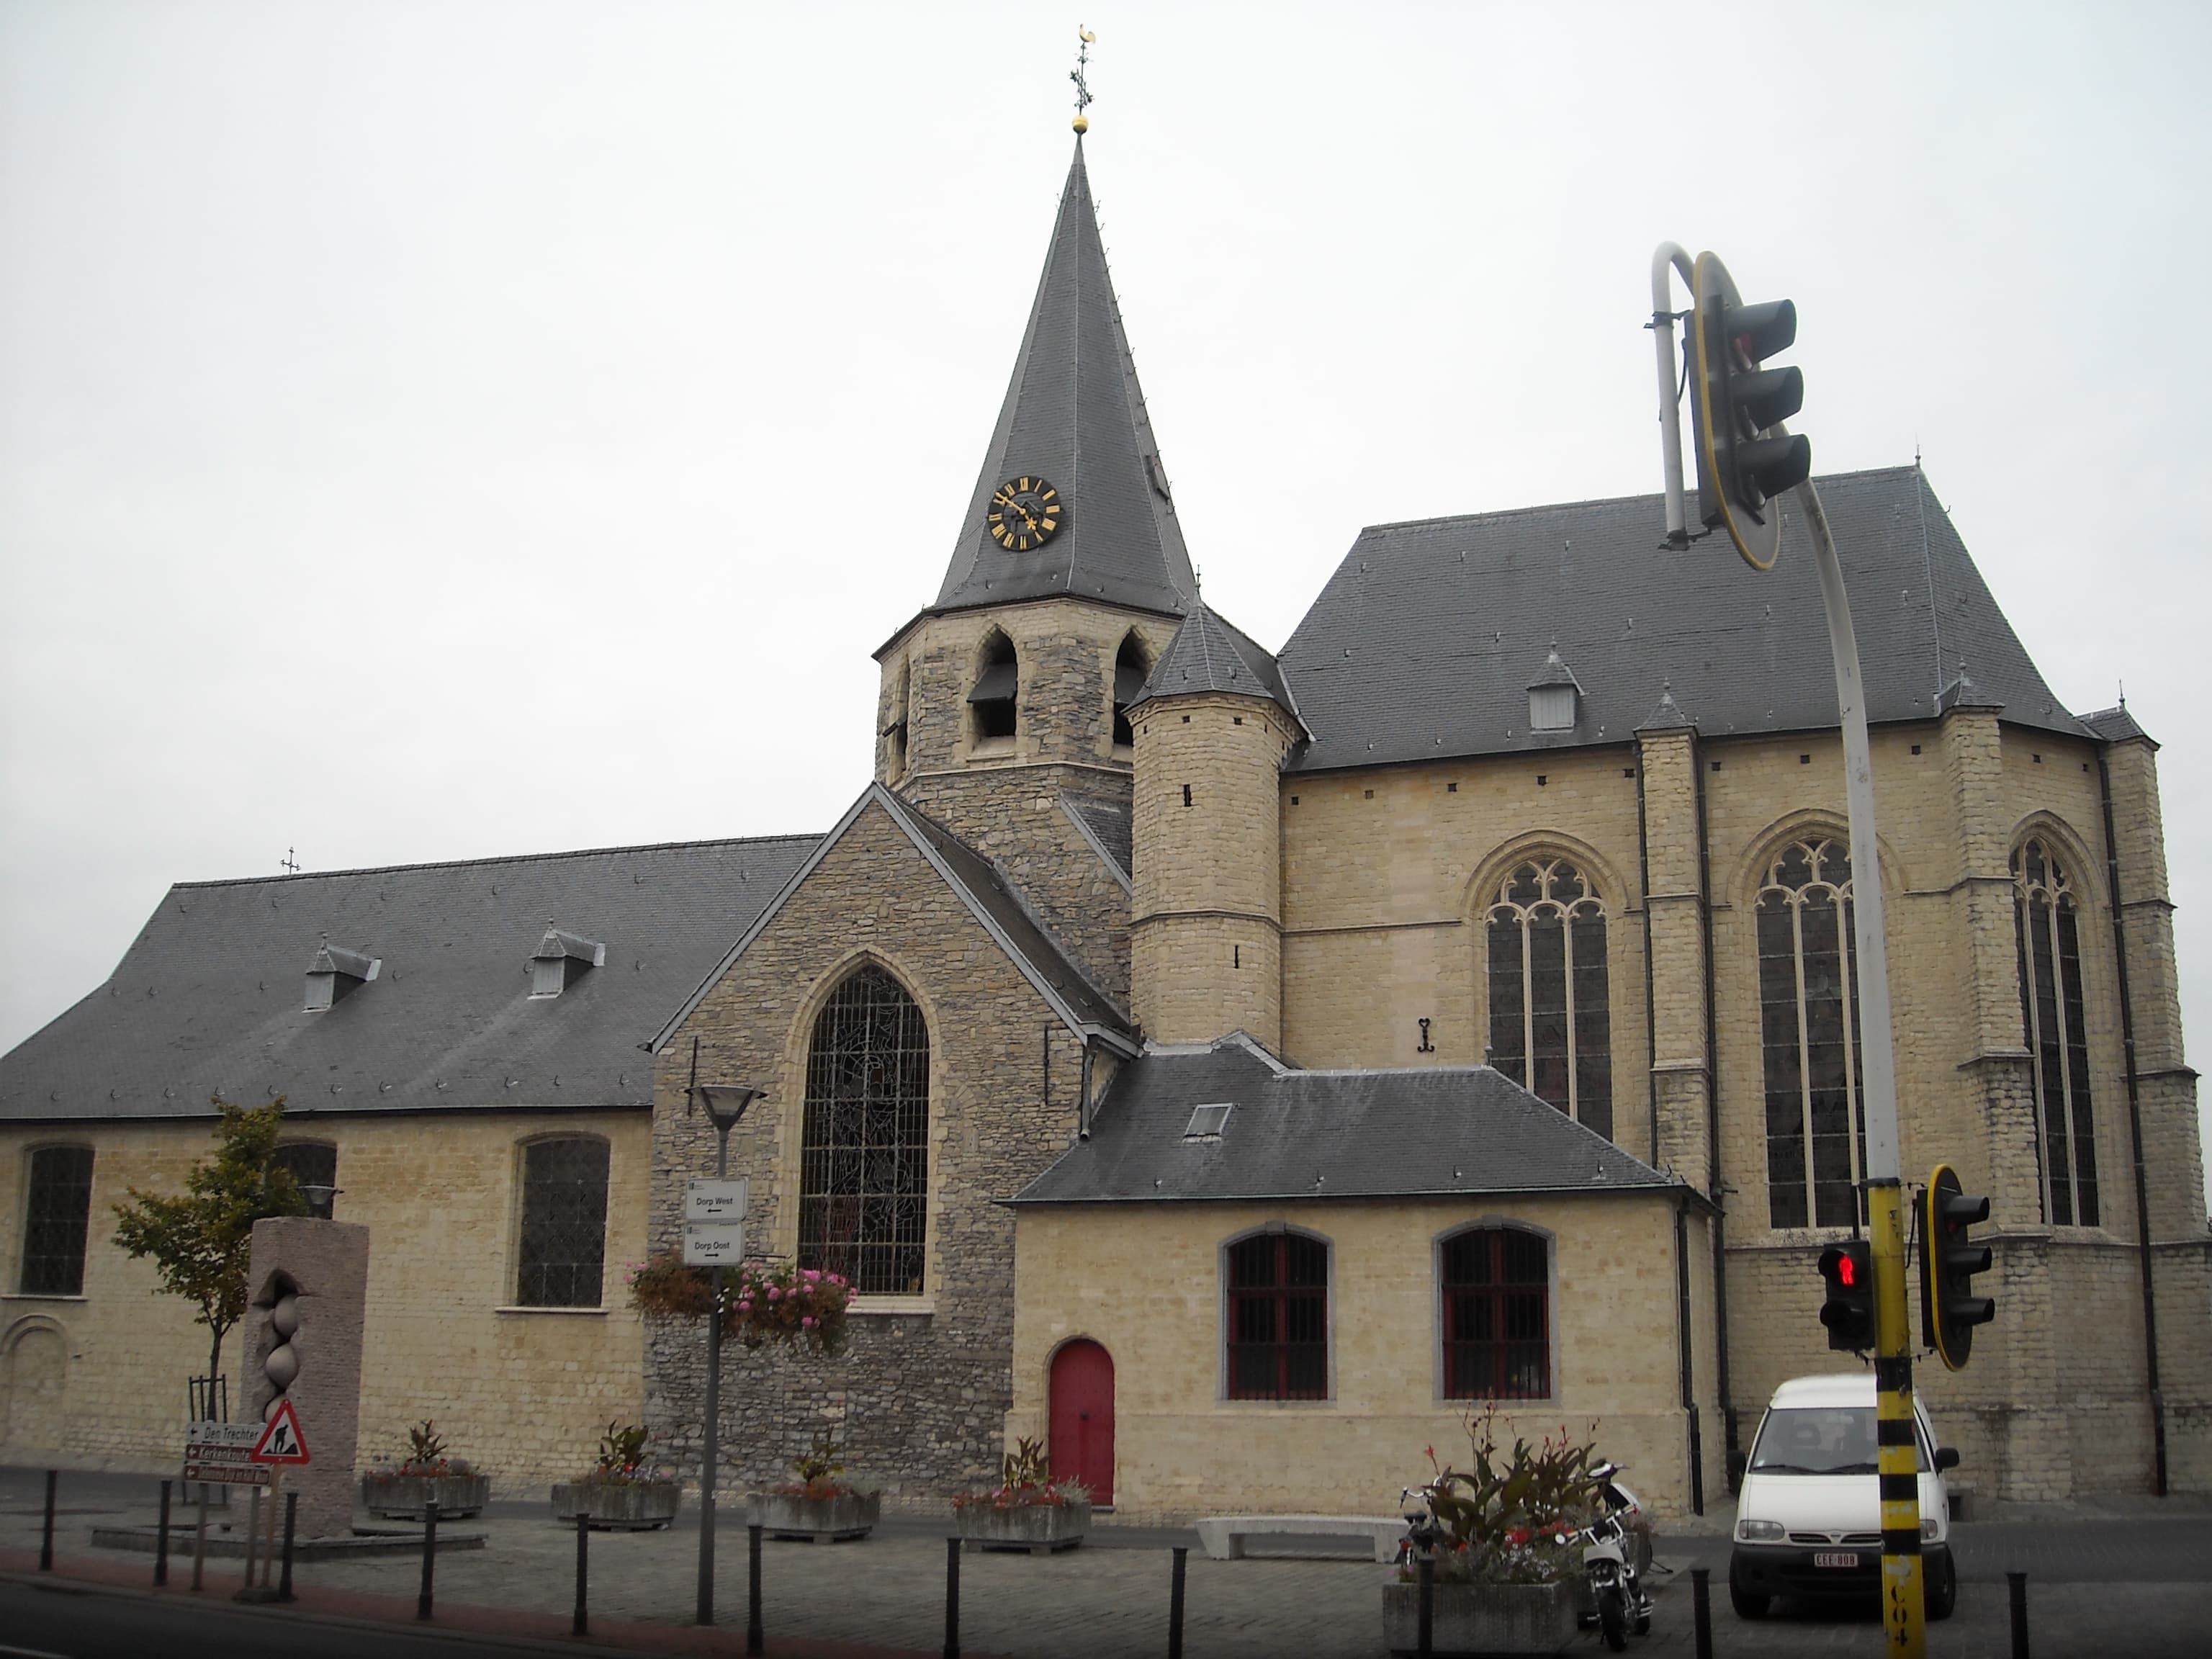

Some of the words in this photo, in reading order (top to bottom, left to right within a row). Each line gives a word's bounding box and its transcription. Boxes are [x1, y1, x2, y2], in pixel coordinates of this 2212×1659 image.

[696, 1197, 714, 1206] Dorp
[694, 1241, 711, 1250] Dorp
[204, 1427, 220, 1439] Den
[224, 1427, 259, 1441] Trechter
